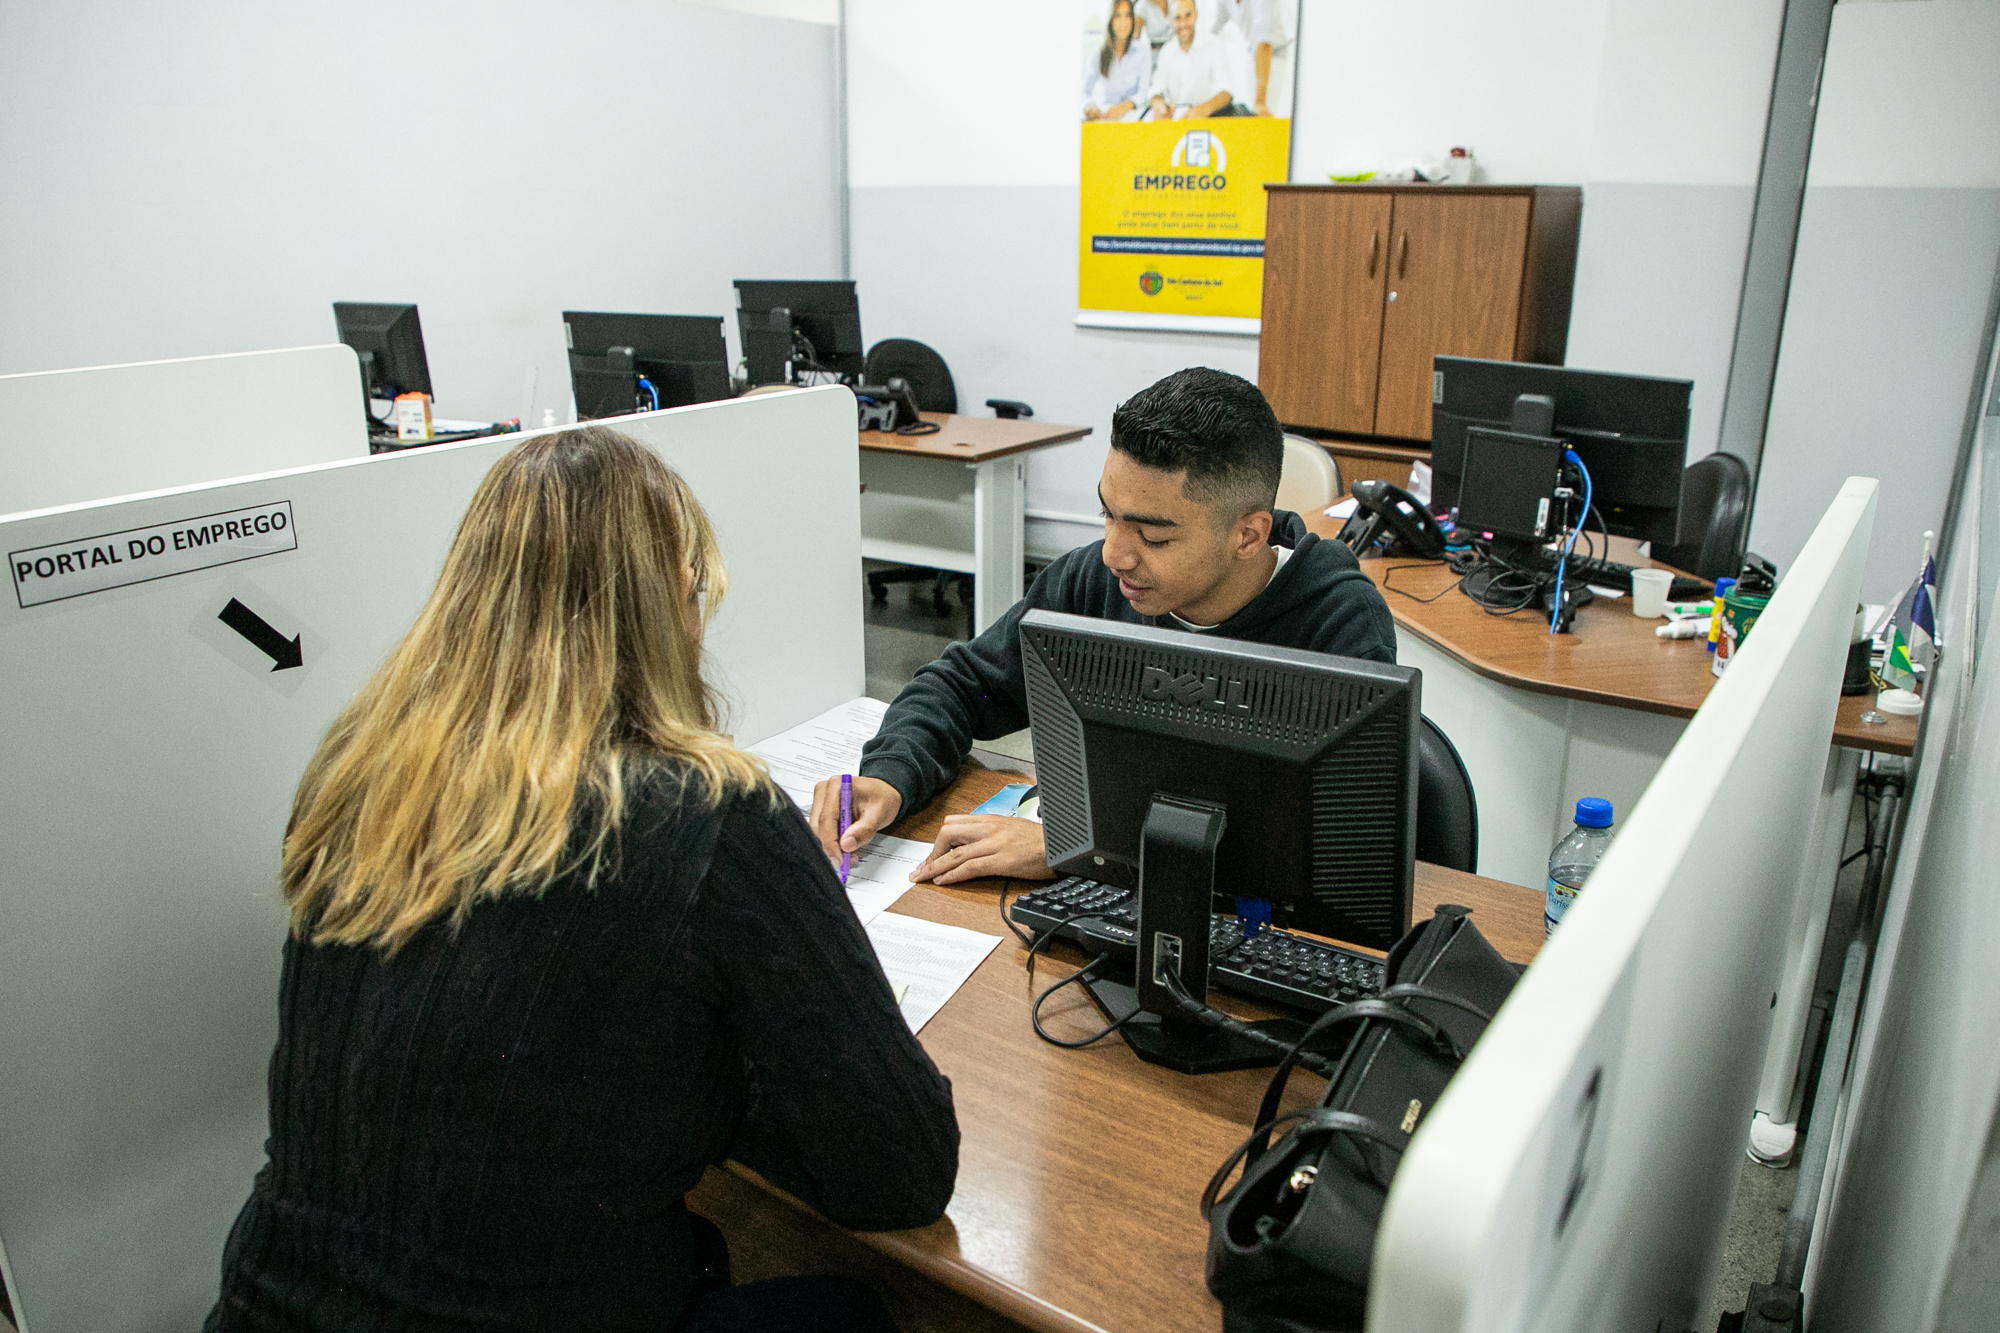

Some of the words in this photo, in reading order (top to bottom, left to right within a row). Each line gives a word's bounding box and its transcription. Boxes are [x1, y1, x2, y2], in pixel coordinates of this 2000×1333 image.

[1133, 174, 1226, 190] EMPREGO
[16, 544, 122, 582] PORTAL
[128, 535, 166, 560] DO
[172, 511, 287, 551] EMPREGO
[1142, 666, 1249, 713] DELL
